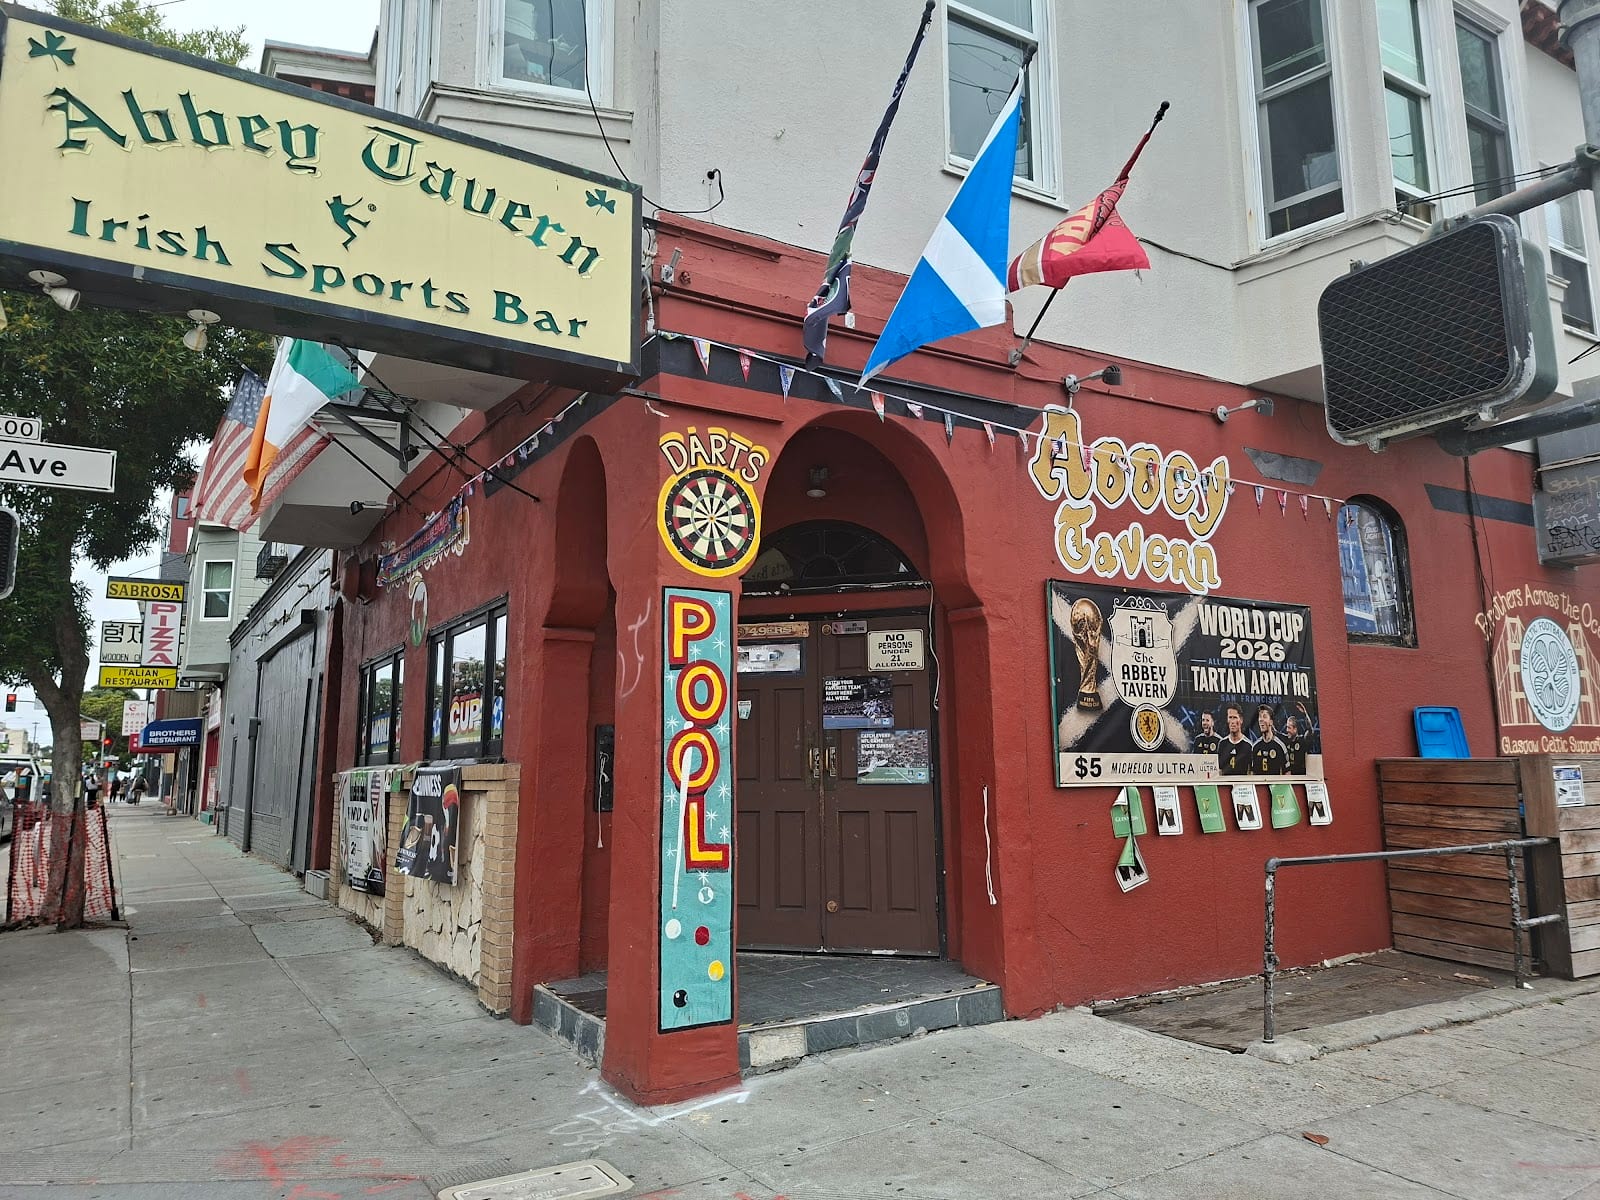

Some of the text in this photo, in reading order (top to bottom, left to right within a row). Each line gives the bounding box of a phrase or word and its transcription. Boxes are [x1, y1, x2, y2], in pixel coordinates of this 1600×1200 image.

[45, 86, 602, 277] Abbey Tavern
[69, 196, 588, 339] Irish Sports Bar
[0, 420, 33, 436] 00
[0, 450, 67, 477] Ave
[660, 431, 766, 482] DARTS
[109, 583, 180, 599] SABROSA
[1525, 583, 1560, 609] Across
[1560, 591, 1579, 621] the
[146, 603, 177, 665] PIZZA
[749, 626, 792, 635] 49ERS
[1198, 604, 1303, 643] WORLD CUP
[878, 641, 912, 649] PERSONS
[1220, 639, 1286, 662] 2026
[1525, 625, 1537, 648] CELTIC
[1538, 622, 1566, 646] FOOTBALL
[1567, 648, 1577, 675] CLUB
[102, 653, 128, 661] WOODEN
[1131, 651, 1154, 663] The
[1224, 659, 1255, 668] MATCHES
[105, 677, 171, 686] RESTAURANT
[1121, 664, 1167, 682] ABBEY
[1191, 666, 1310, 698] TARTAN ARMY HQ
[1122, 682, 1168, 698] TAVERN
[1241, 695, 1282, 704] FRANCISCO
[450, 697, 481, 732] CUP
[668, 595, 729, 869] POOL
[1502, 735, 1539, 755] Glasgow
[1540, 735, 1568, 753] Celtic
[1075, 755, 1102, 779] $5
[1111, 762, 1153, 774] MICHELOB
[1157, 763, 1195, 774] ULTRA
